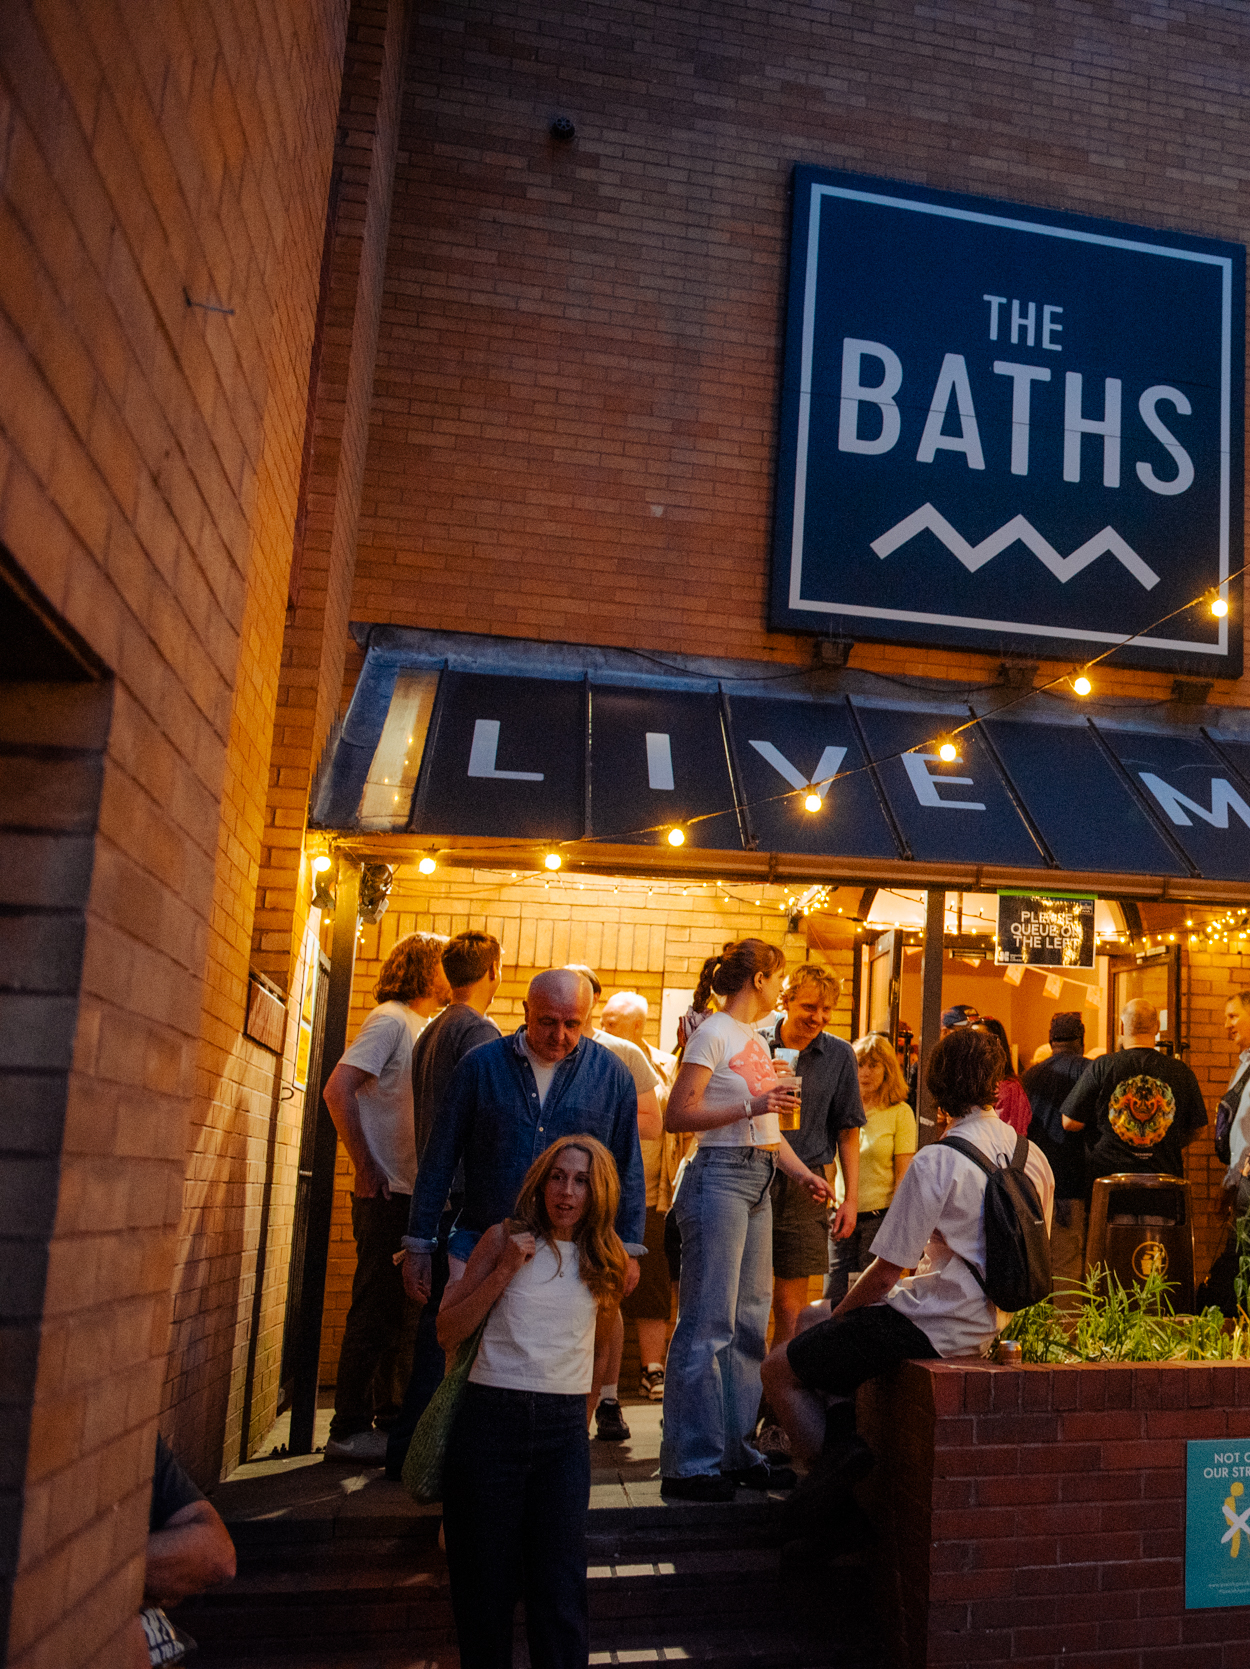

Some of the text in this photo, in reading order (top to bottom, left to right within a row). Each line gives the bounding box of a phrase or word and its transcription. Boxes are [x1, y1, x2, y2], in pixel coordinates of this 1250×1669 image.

[983, 294, 1063, 351] THE
[838, 337, 1195, 496] BATHS
[467, 719, 986, 811] LIVE
[1011, 923, 1059, 936] QUEUE
[1013, 935, 1080, 949] THE LEFT
[1214, 1452, 1240, 1464] NOT
[1203, 1467, 1229, 1479] OUR
